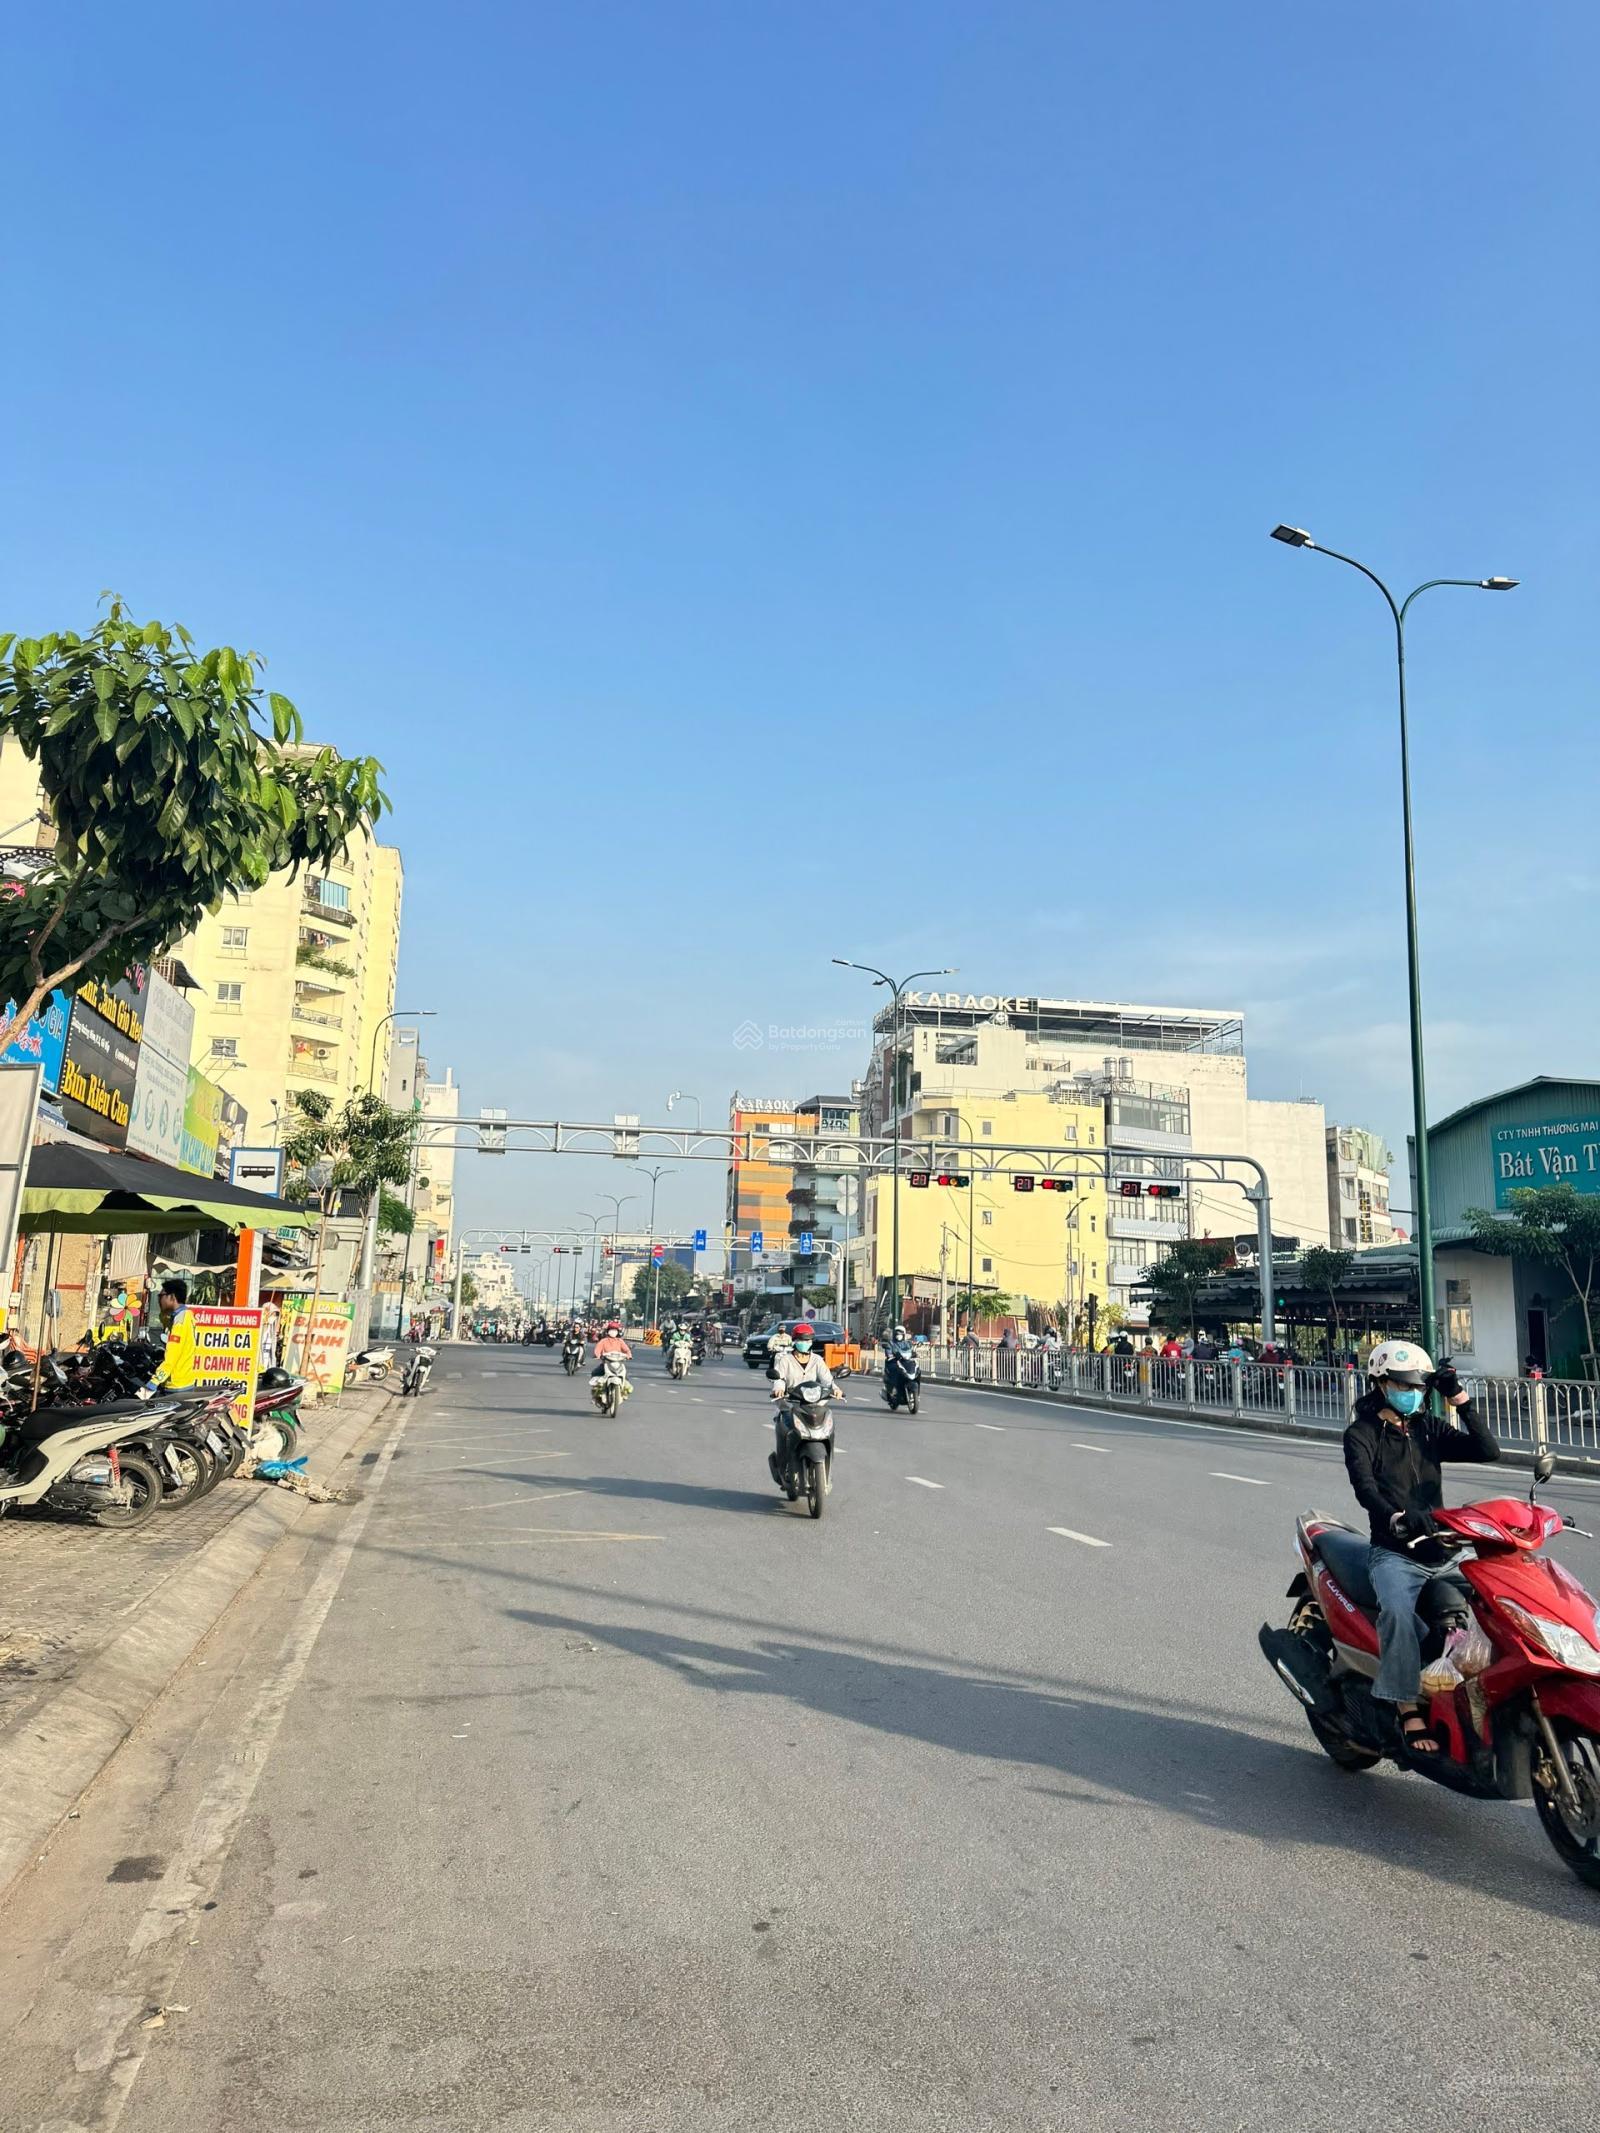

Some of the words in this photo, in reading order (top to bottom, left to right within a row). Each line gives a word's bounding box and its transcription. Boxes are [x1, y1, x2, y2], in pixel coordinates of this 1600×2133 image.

[908, 991, 1030, 1012] KARAOKE
[129, 1010, 142, 1043] Heo
[62, 1060, 87, 1104] Bún
[87, 1074, 111, 1115] Riêu
[111, 1089, 129, 1127] Cua
[1497, 1129, 1514, 1141] CTY
[1516, 1127, 1541, 1138] TNHH
[1542, 1122, 1580, 1135] THƯƠNG
[1581, 1121, 1599, 1133] MẠI
[1499, 1151, 1534, 1178] Bát
[1538, 1147, 1578, 1181] Vận
[1583, 1143, 1600, 1171] T
[912, 1174, 927, 1185] 27
[1016, 1178, 1031, 1189] 27
[1123, 1183, 1138, 1195] 27
[213, 1314, 230, 1325] NHA
[231, 1315, 258, 1326] TRANG
[204, 1328, 230, 1348] CHẢ
[234, 1331, 251, 1348] CÁ
[204, 1356, 234, 1371] CANH
[237, 1357, 251, 1376] HẸ
